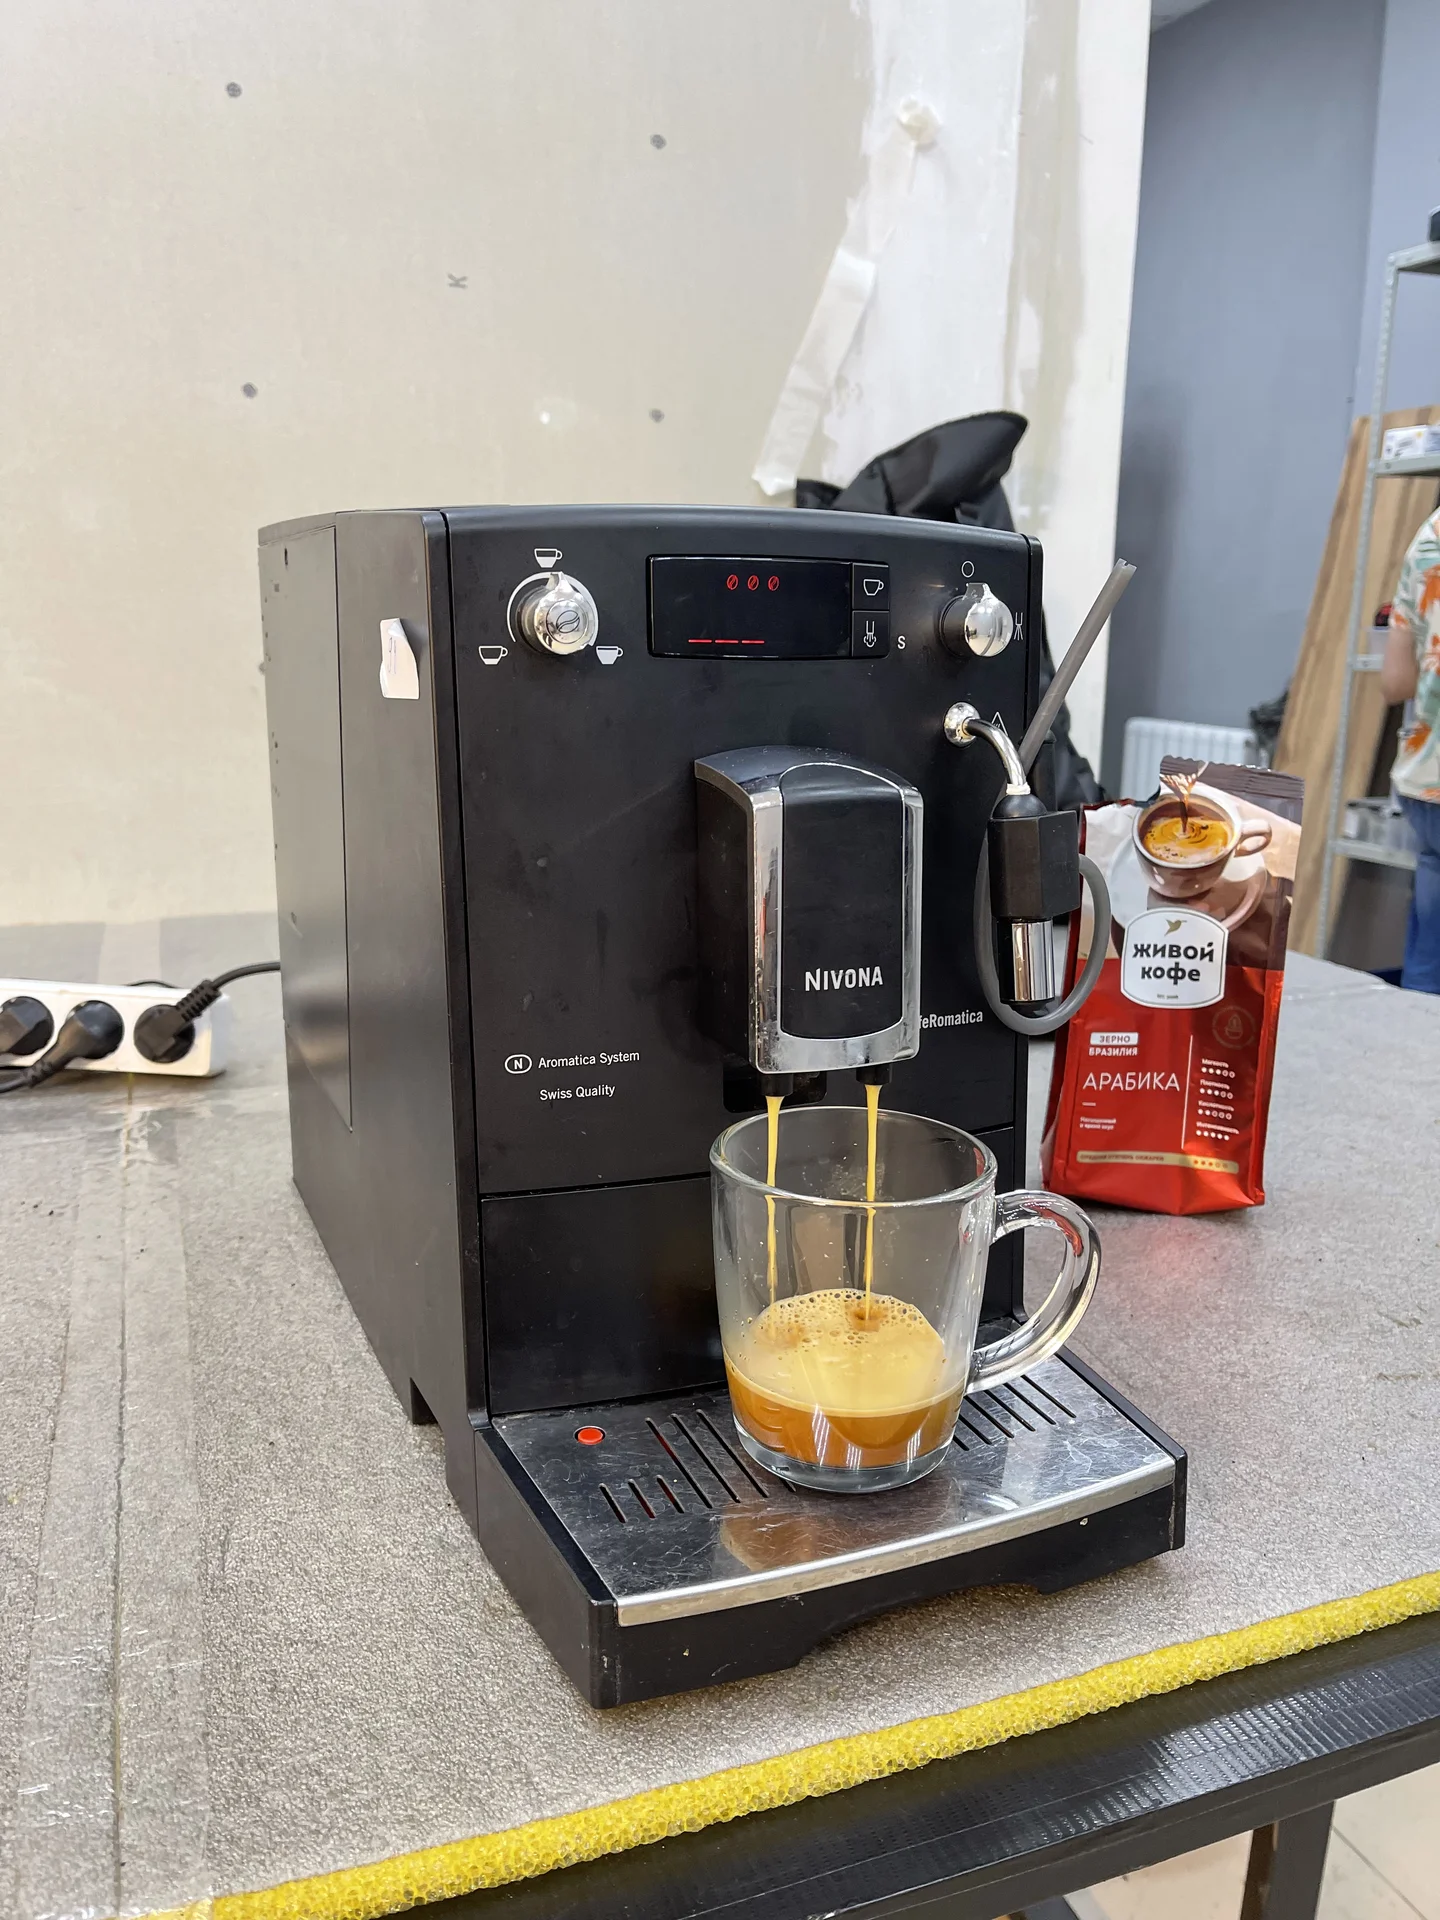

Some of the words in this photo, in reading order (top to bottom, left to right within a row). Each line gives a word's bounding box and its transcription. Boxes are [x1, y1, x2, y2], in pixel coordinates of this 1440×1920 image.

[897, 635, 906, 650] S
[1132, 941, 1215, 963] живой
[805, 965, 884, 992] NIVONA
[1140, 961, 1201, 986] кофе
[1099, 1034, 1131, 1044] ЗЕРНО
[513, 1058, 524, 1070] N
[538, 1053, 597, 1069] Aromatica
[599, 1051, 641, 1066] System
[1088, 1046, 1139, 1057] БРАЗИЛИЯ
[1082, 1071, 1181, 1093] АРАБИКА
[539, 1088, 573, 1101] Swiss
[575, 1084, 616, 1098] Quality
